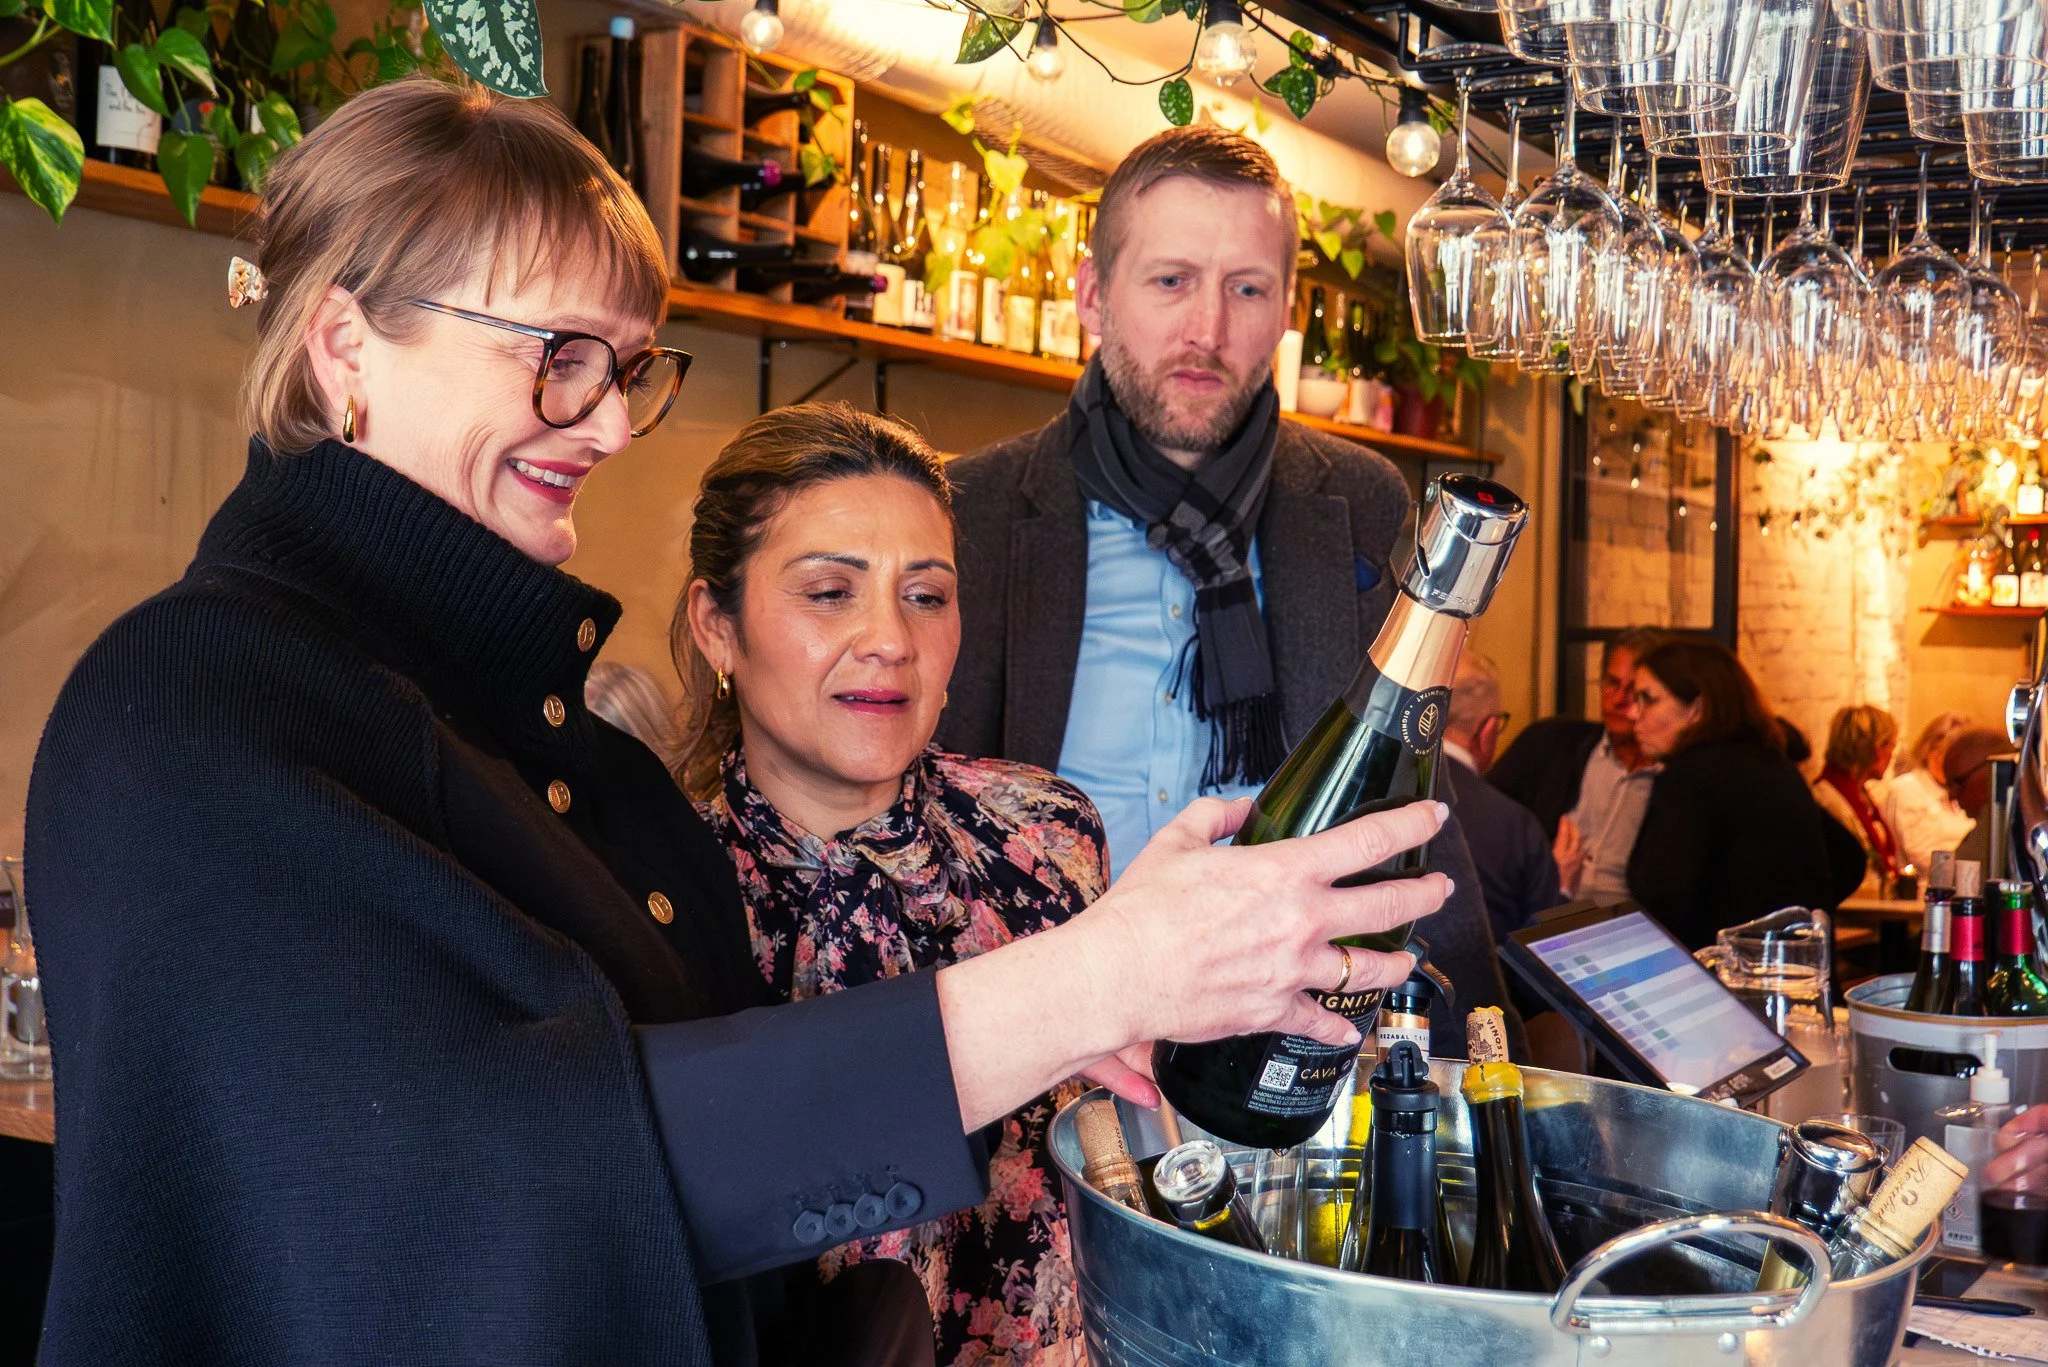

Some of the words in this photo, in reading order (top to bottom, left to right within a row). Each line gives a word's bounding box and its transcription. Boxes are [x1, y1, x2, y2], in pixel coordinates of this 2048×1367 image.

[1316, 991, 1380, 1008] IGNITA
[1487, 1019, 1502, 1050] VINOS
[1300, 1065, 1336, 1080] CAVA
